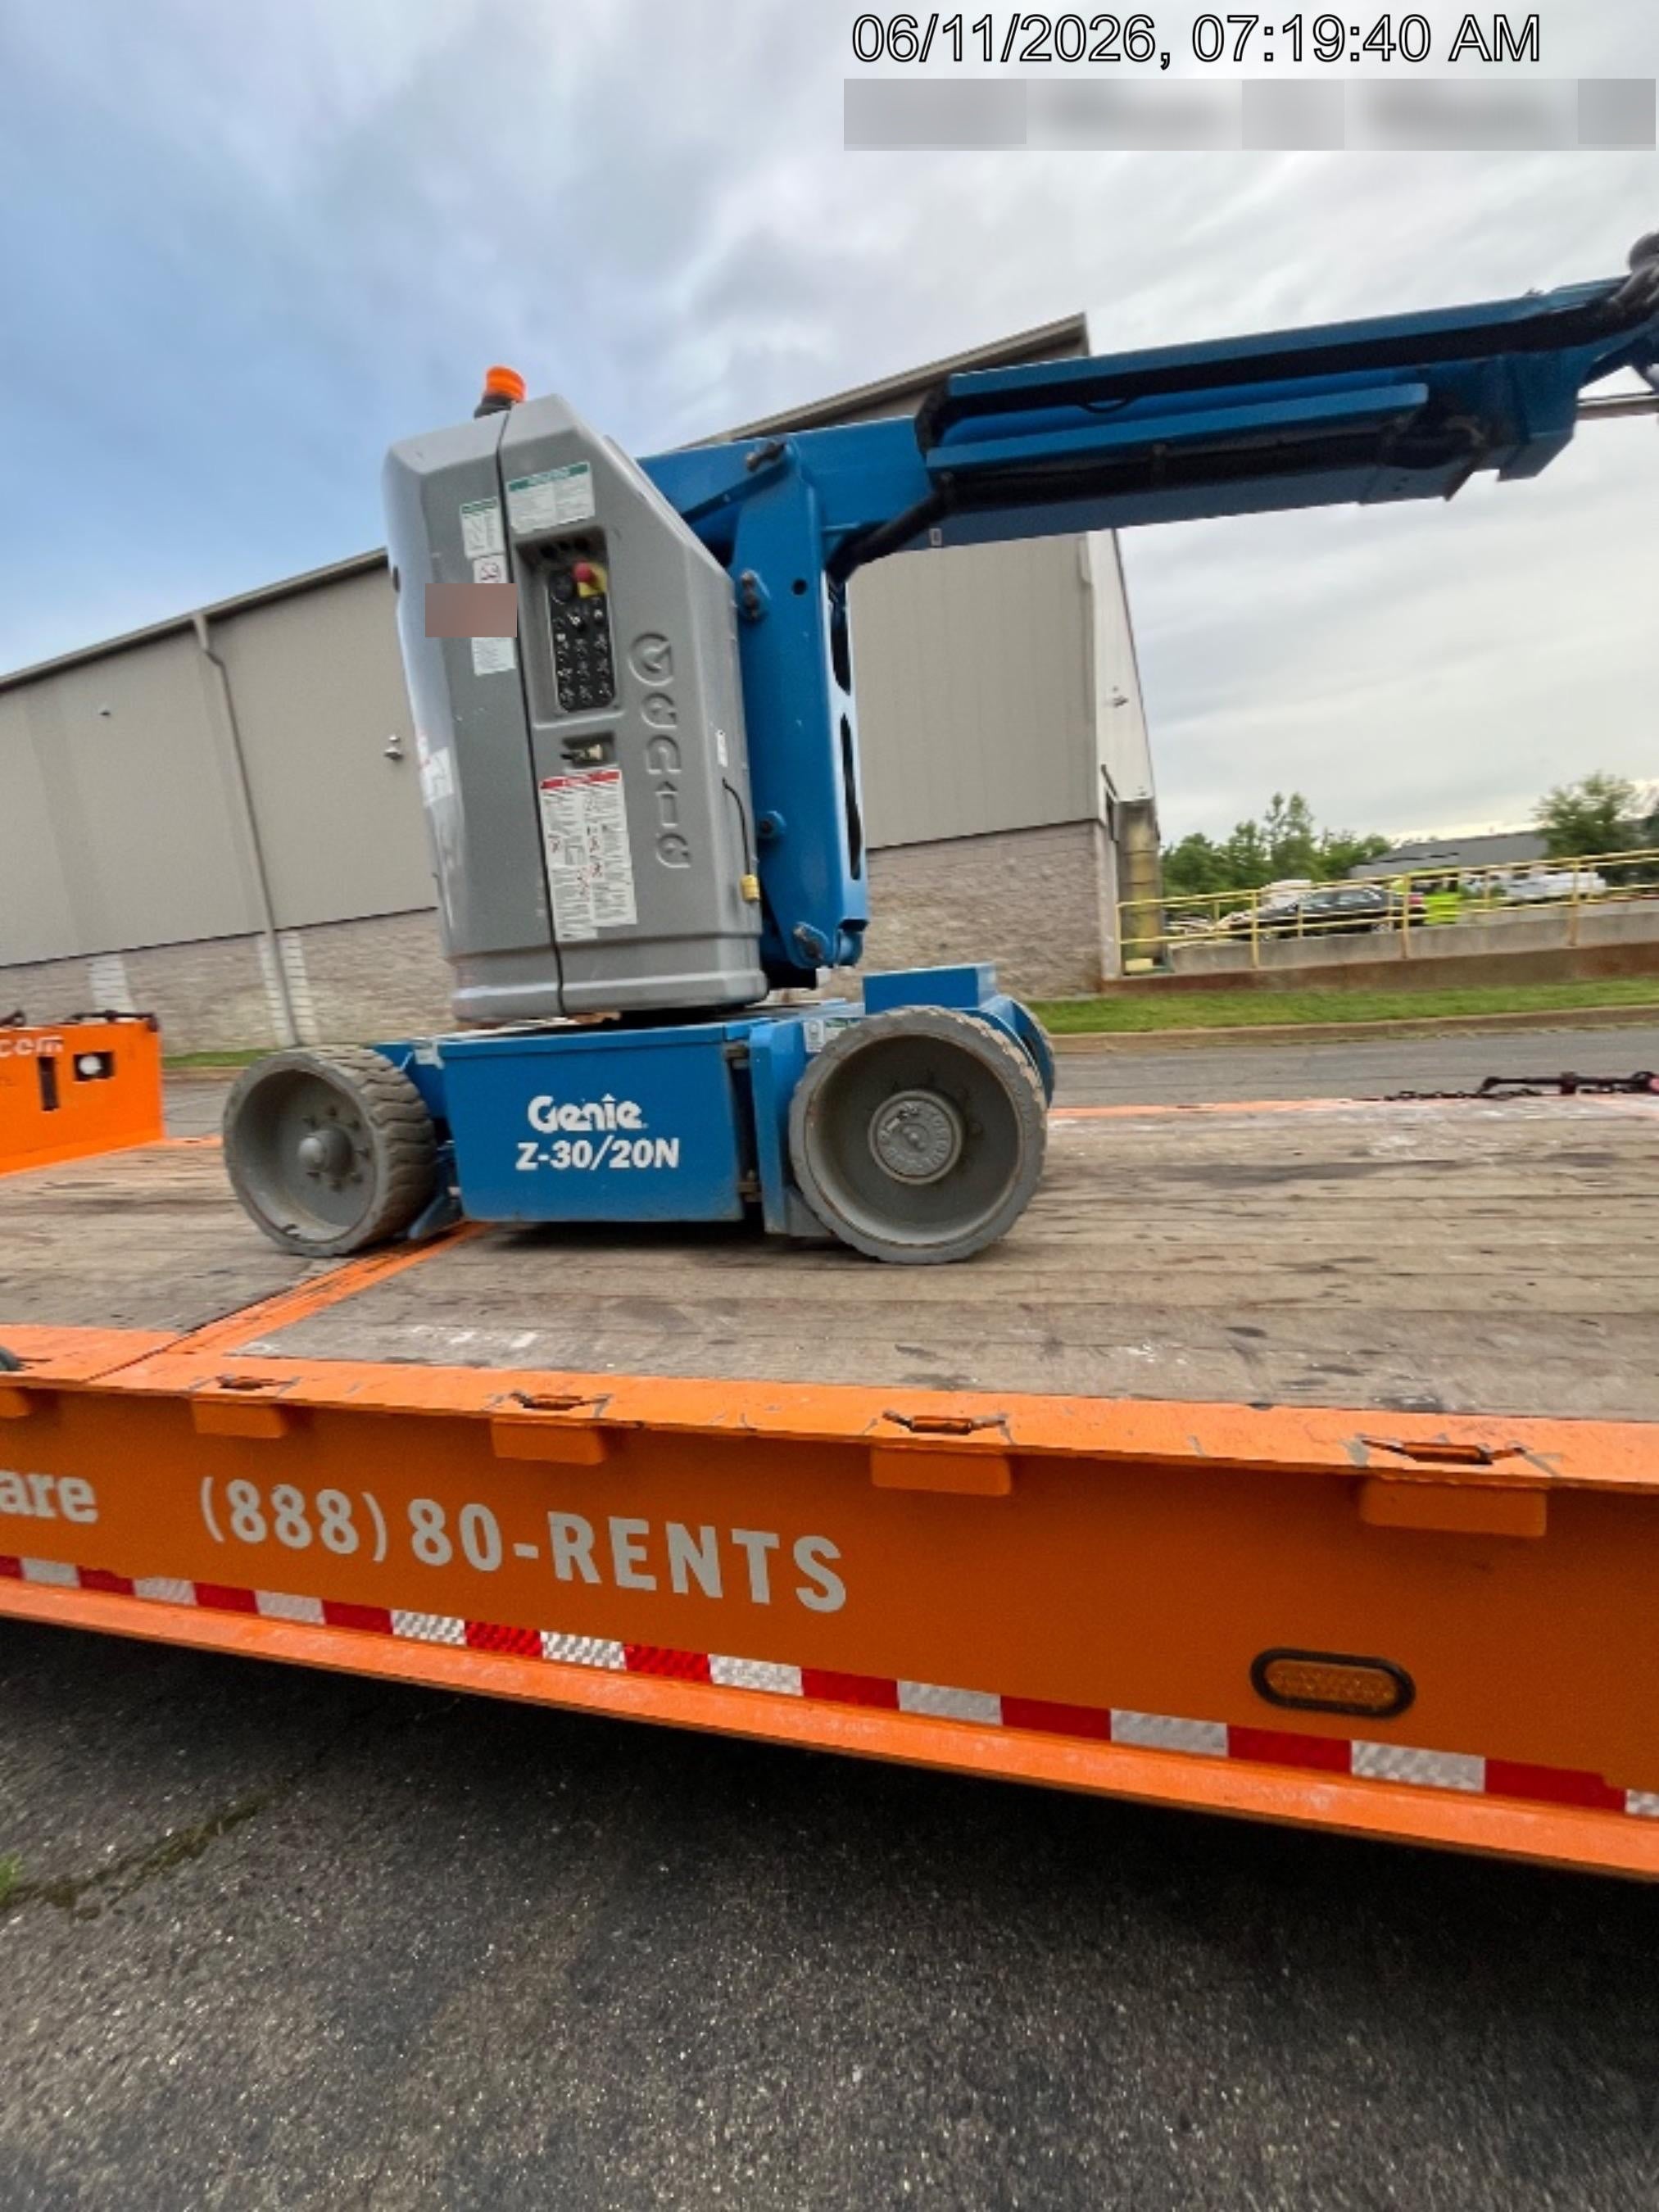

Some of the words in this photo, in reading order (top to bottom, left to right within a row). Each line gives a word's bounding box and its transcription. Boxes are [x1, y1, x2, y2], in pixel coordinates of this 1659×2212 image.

[527, 1092, 644, 1134] Genie
[515, 1134, 680, 1171] Z-30/20N
[199, 1475, 388, 1562] (888)
[408, 1498, 848, 1613] 80-RENTS
